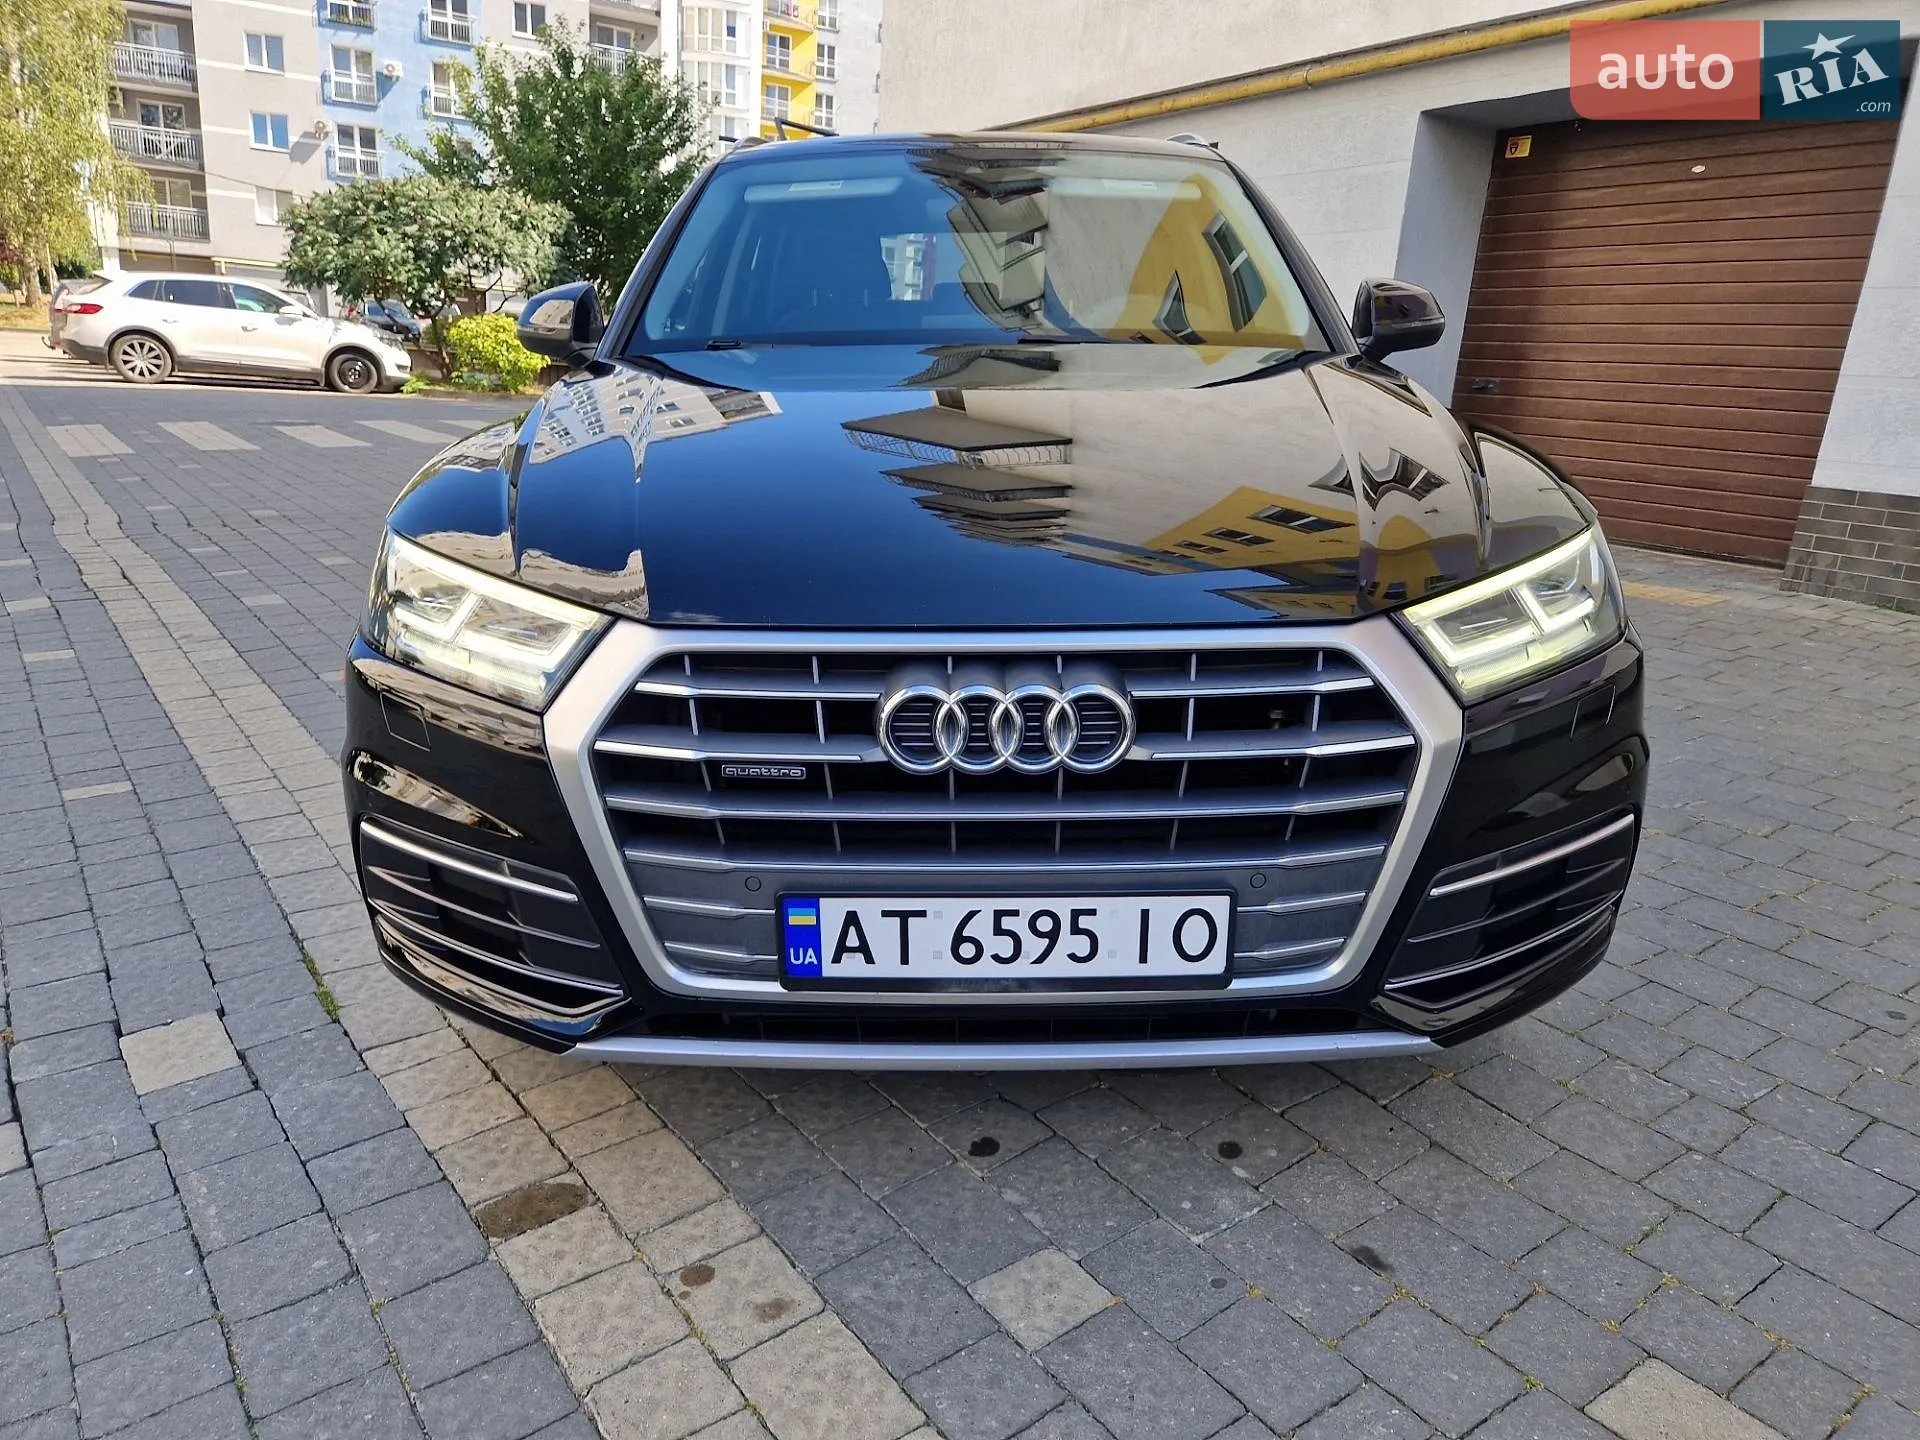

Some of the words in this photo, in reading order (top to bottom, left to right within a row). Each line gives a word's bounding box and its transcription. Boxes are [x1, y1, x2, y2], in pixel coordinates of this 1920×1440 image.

[725, 767, 802, 777] quattro
[830, 909, 928, 966] AT
[949, 908, 1100, 966] 6595
[1137, 907, 1219, 965] IO
[789, 947, 819, 966] UA
